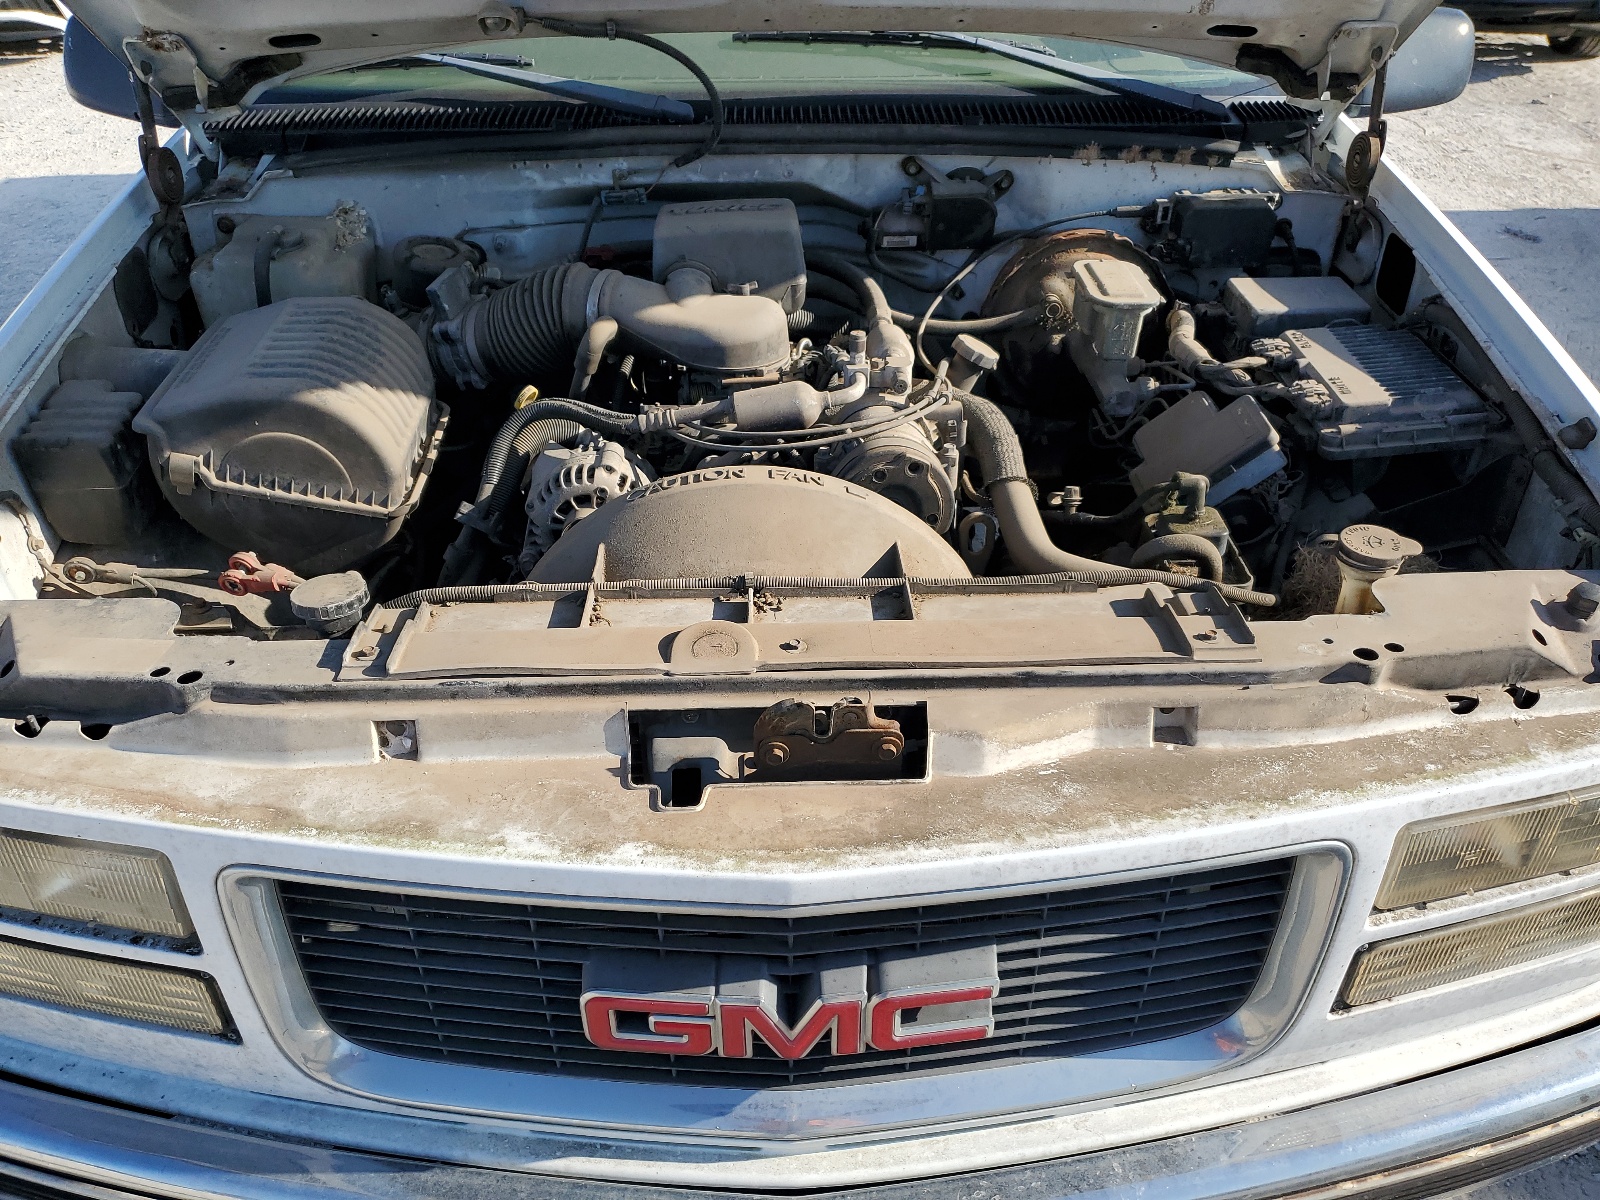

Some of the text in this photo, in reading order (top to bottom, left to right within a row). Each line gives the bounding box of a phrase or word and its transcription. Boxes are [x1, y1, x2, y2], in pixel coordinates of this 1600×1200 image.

[626, 468, 746, 502] CAUTION
[767, 468, 825, 487] FAN
[580, 978, 1000, 1059] GMC
